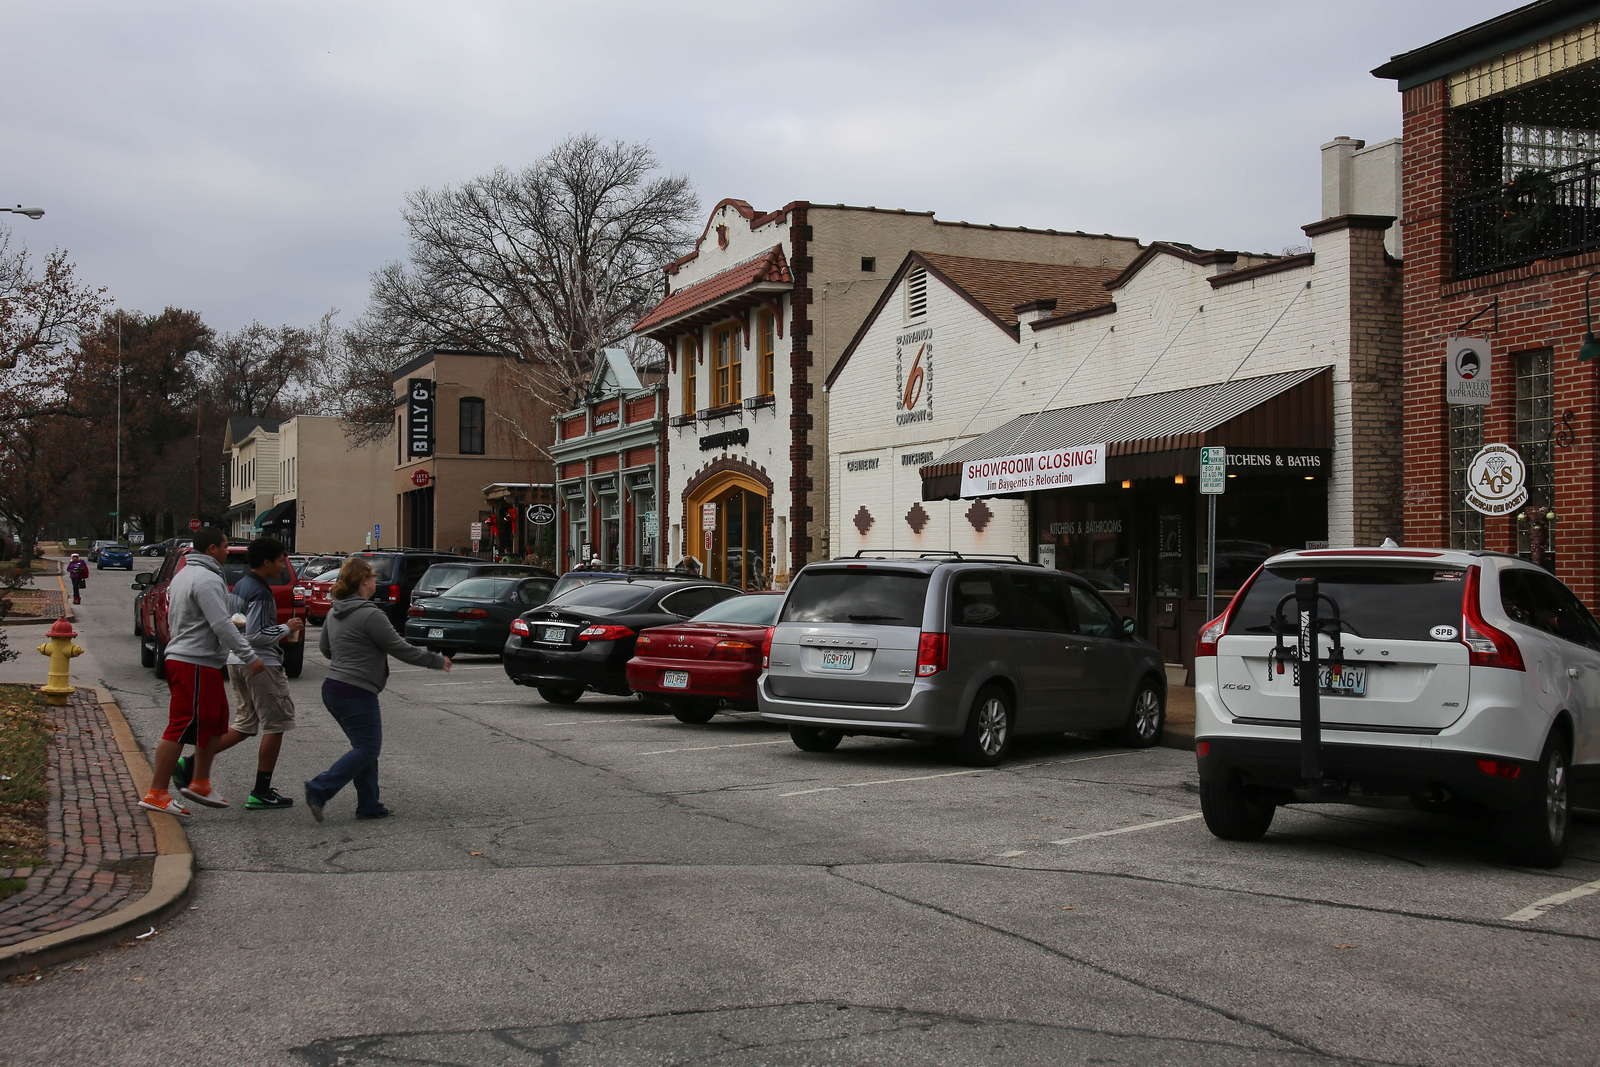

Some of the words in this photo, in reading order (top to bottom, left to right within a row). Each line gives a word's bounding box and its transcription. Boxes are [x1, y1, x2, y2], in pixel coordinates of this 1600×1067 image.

[1447, 389, 1490, 398] APPRAISALS
[1458, 381, 1489, 391] JEWELRY
[413, 405, 428, 452] BILLY
[901, 451, 934, 466] KITCHENS
[968, 457, 1035, 480] SHOWROOM
[1038, 449, 1099, 471] CLOSING!
[1202, 451, 1208, 463] 2
[1225, 455, 1271, 466] ITCHENS
[1275, 455, 1284, 466] &
[1288, 456, 1321, 466] BATHS
[987, 480, 997, 491] Jim
[998, 476, 1028, 491] Baygents
[1028, 476, 1035, 487] is
[1035, 471, 1073, 486] Relocating
[1467, 494, 1493, 513] AMERICAN
[1493, 504, 1505, 513] GEM
[1505, 491, 1526, 511] SOCIETY
[1050, 522, 1075, 534] KITCHENS
[1077, 522, 1082, 534] &
[1085, 519, 1123, 533] BATHROOMS
[1435, 628, 1453, 636] SPB
